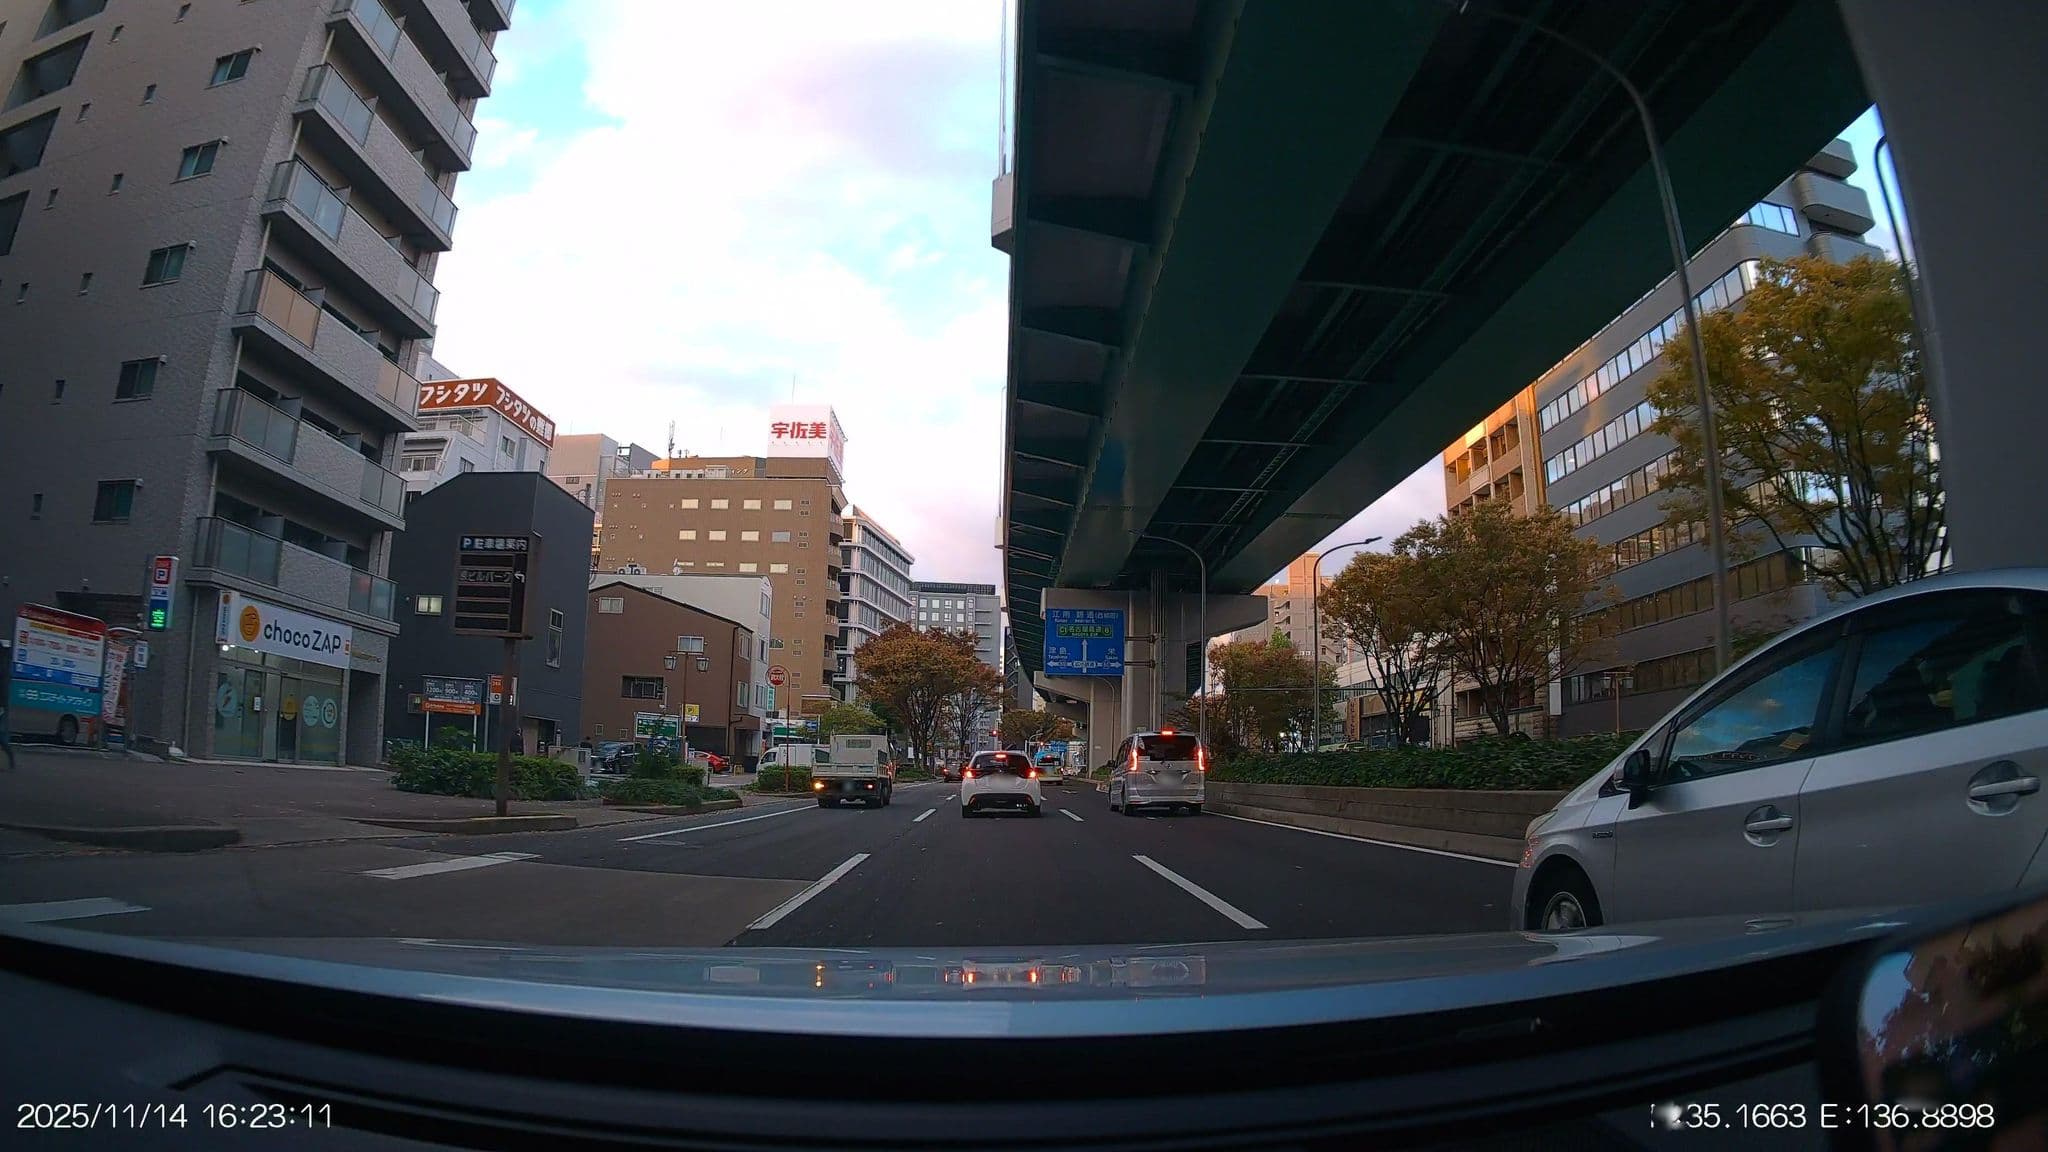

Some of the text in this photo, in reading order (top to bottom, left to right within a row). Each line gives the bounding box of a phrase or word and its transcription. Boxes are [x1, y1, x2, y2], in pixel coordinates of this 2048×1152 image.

[771, 421, 827, 439] 宇佐美
[263, 619, 342, 655] chocoZAP
